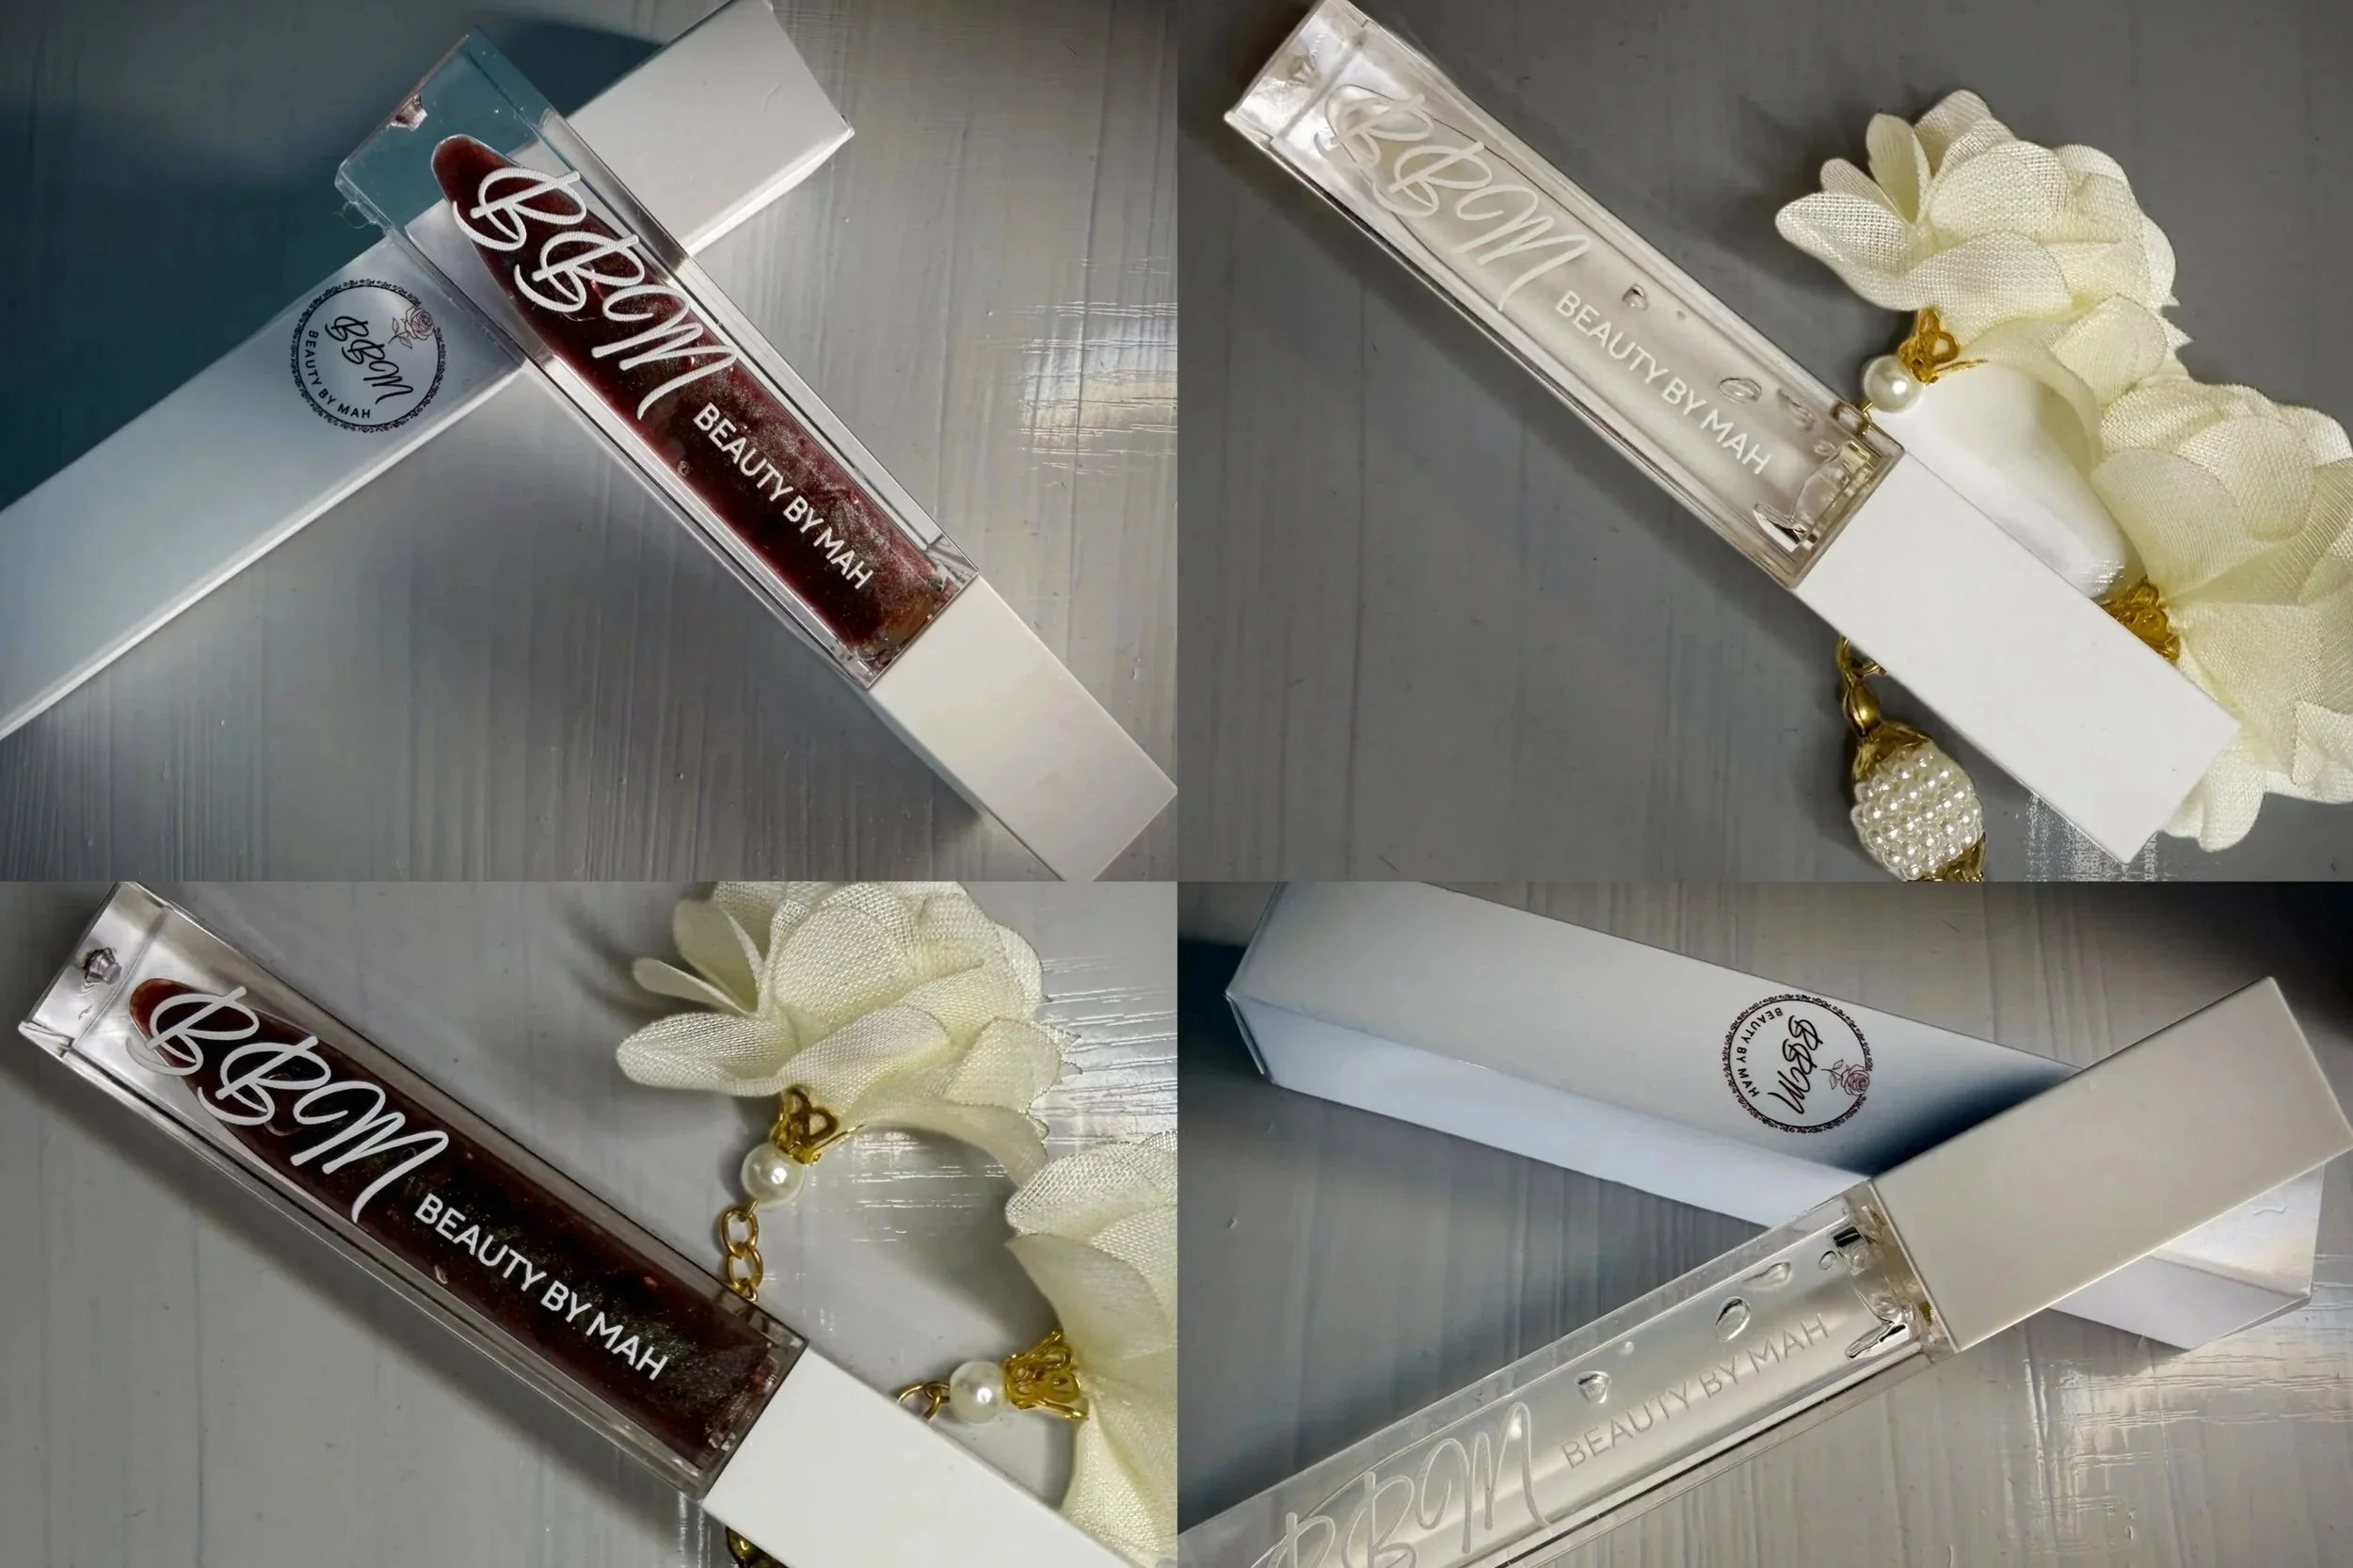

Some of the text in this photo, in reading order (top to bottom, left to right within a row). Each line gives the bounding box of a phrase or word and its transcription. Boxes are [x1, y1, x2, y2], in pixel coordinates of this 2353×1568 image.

[304, 329, 371, 419] BEAUTY BY MAH
[325, 315, 414, 405] BBM
[453, 168, 737, 420] BBM
[1554, 289, 1772, 475] BEAUTY BY MAH
[693, 402, 873, 590] BEAUTY BY MAH
[125, 986, 449, 1224] BBM
[1736, 1007, 1784, 1097] BEAUTY BY MAH
[414, 1192, 669, 1381] BEAUTY BY MAH
[1561, 1313, 1829, 1468] BEAUTY BY MAH
